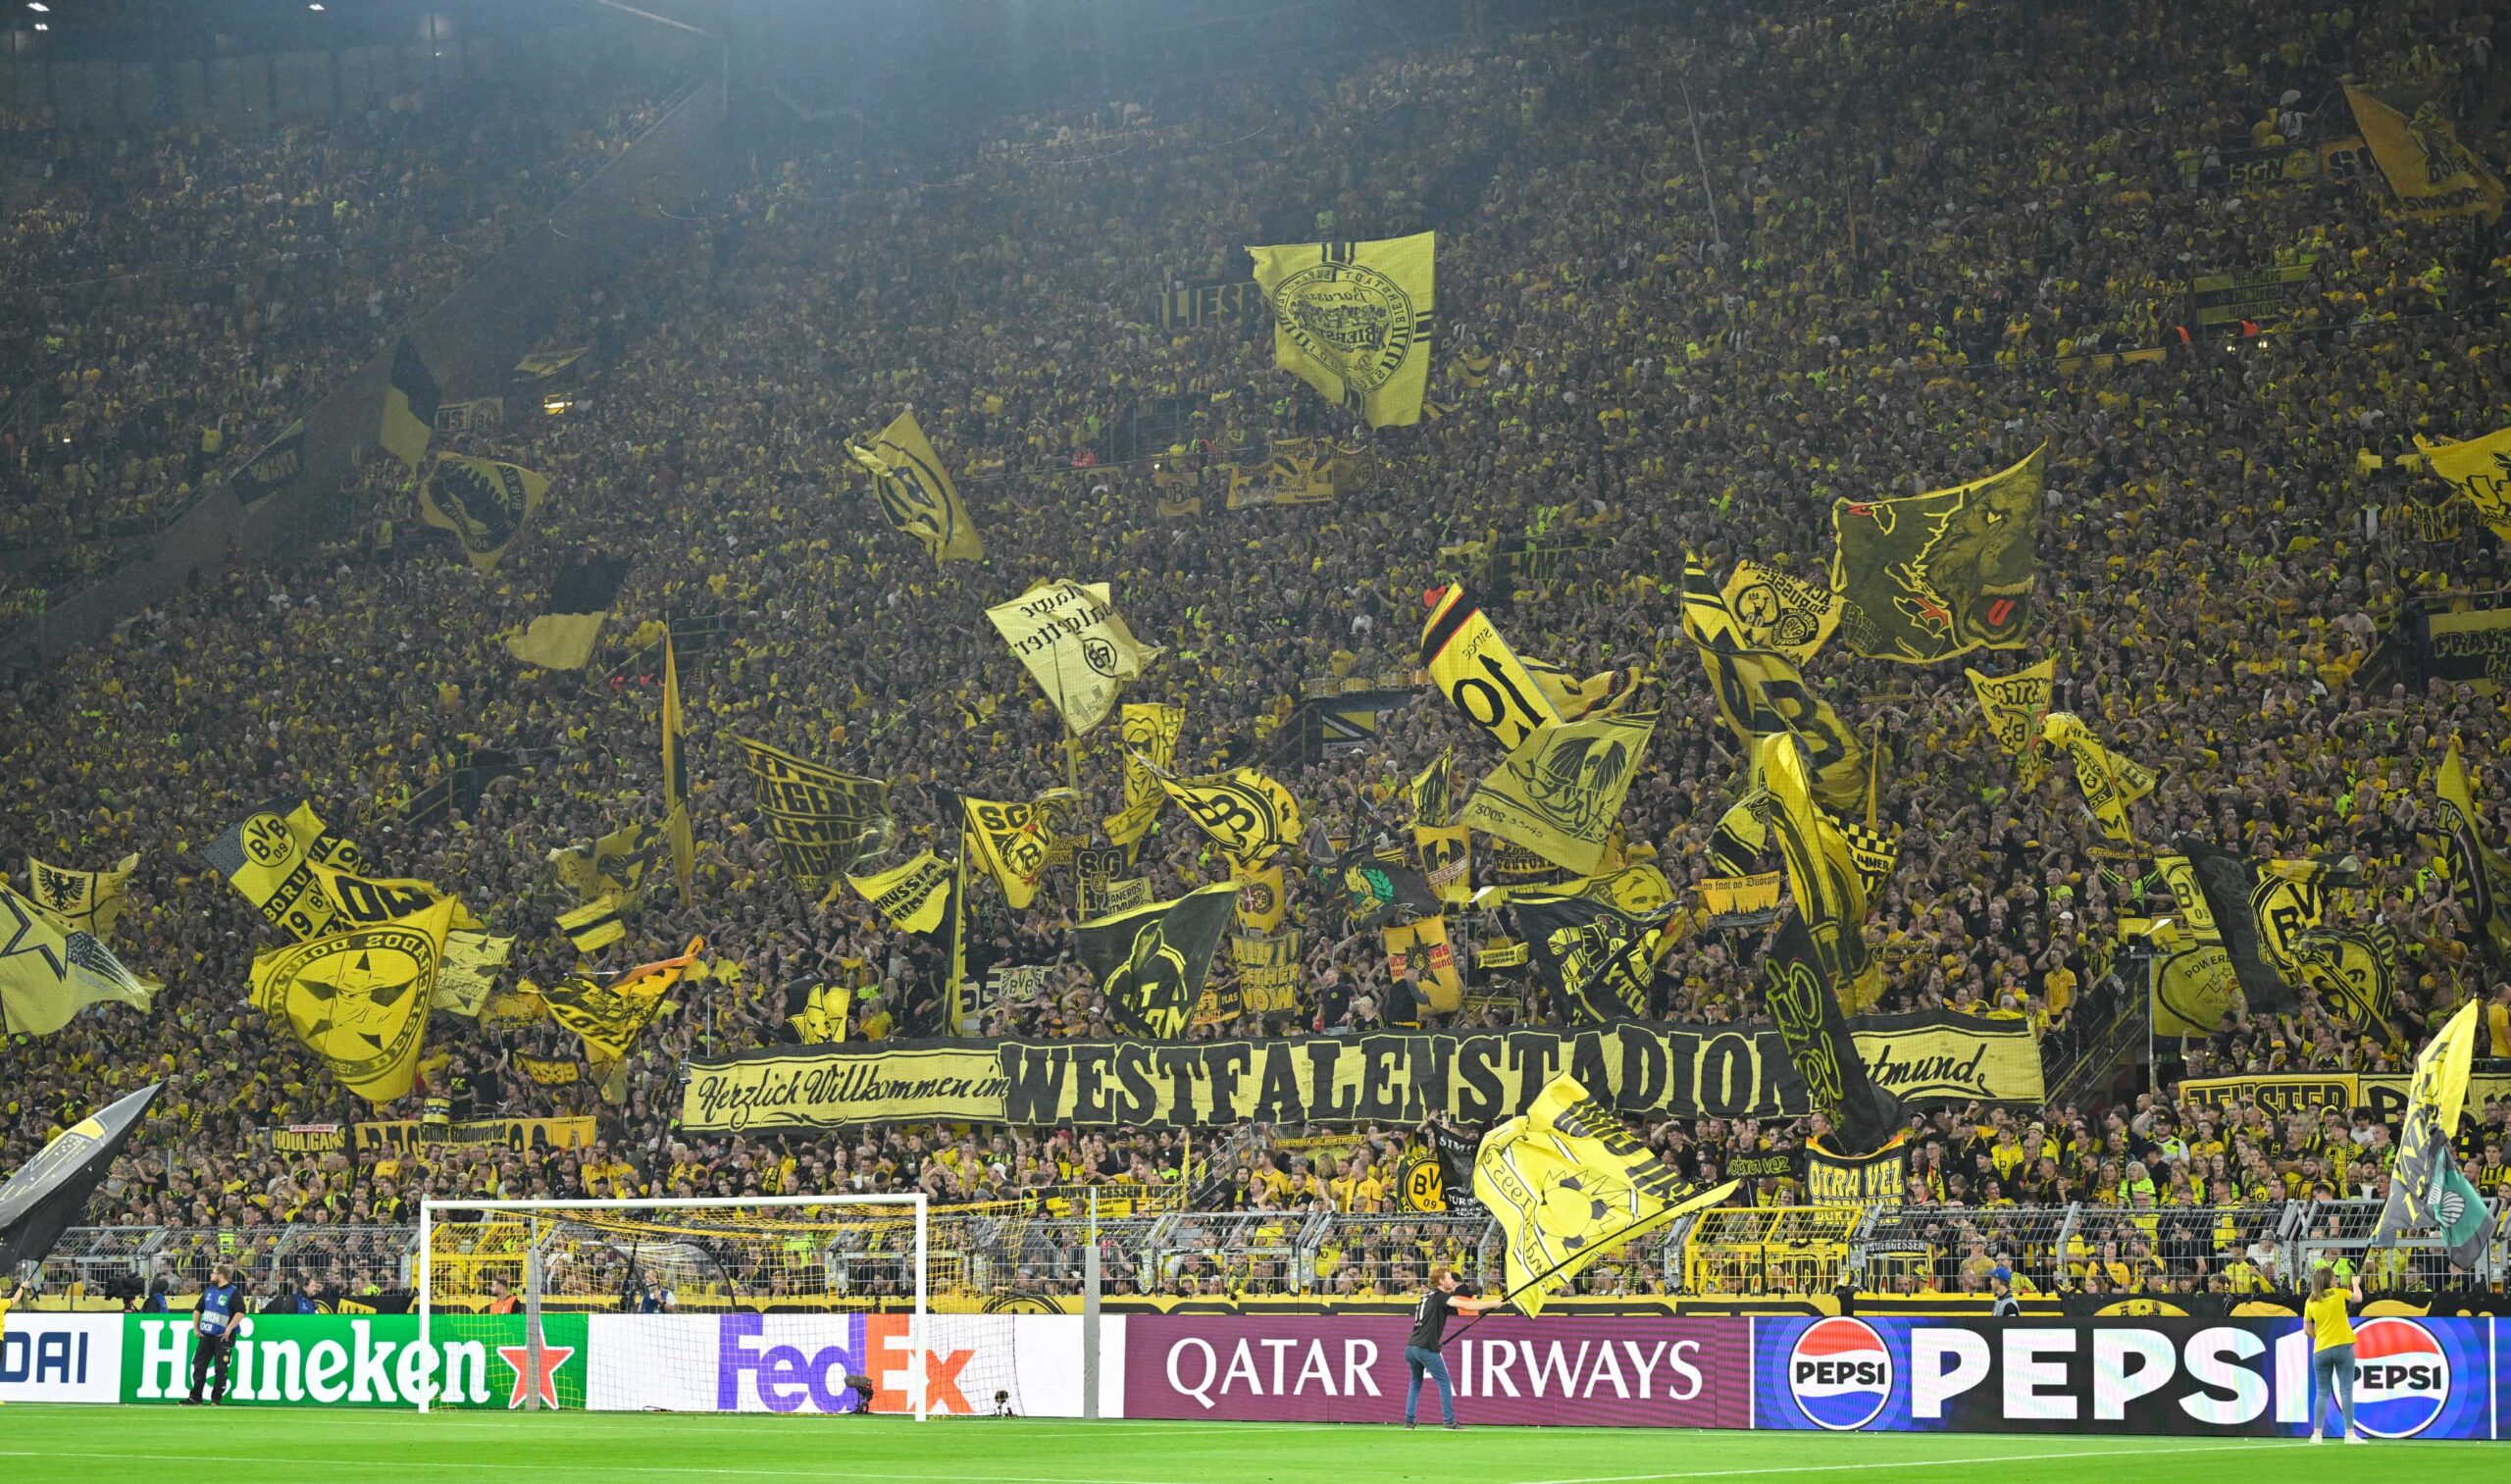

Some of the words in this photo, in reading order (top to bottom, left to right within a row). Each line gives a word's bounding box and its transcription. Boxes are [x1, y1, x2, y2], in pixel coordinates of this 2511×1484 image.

[249, 818, 287, 861] BVB
[273, 843, 288, 860] 09
[1077, 851, 1122, 879] SG
[1857, 853, 1889, 870] IMMER
[262, 836, 337, 922] BORUSIA
[2174, 871, 2201, 908] BV
[308, 883, 326, 909] BV
[1109, 895, 1141, 914] TMUND
[2270, 882, 2325, 952] BV
[1009, 972, 1034, 994] BVB
[999, 1023, 1816, 1126] WESTFALENSTADION
[699, 1067, 798, 1131] Herzlich
[802, 1063, 974, 1106] Willkommen
[974, 1073, 1012, 1099] im
[273, 1129, 346, 1151] HOOLIGANS
[1728, 1154, 1762, 1176] otra
[1763, 1155, 1790, 1174] vez
[1809, 1160, 1861, 1198] OTRA
[1865, 1156, 1905, 1198] VEZ
[1060, 1185, 1143, 1199] UNVEGESSEN
[1413, 1167, 1444, 1196] BV
[1422, 1198, 1437, 1209] 09
[1812, 1195, 1904, 1226] DORTND
[136, 1318, 490, 1404] Hineken
[717, 1313, 977, 1414] FedEx
[1167, 1337, 1382, 1409] QATAR
[1424, 1340, 1704, 1402] IRWAYS
[1795, 1361, 1886, 1385] PEPSI
[1910, 1326, 2310, 1425] PEPSI
